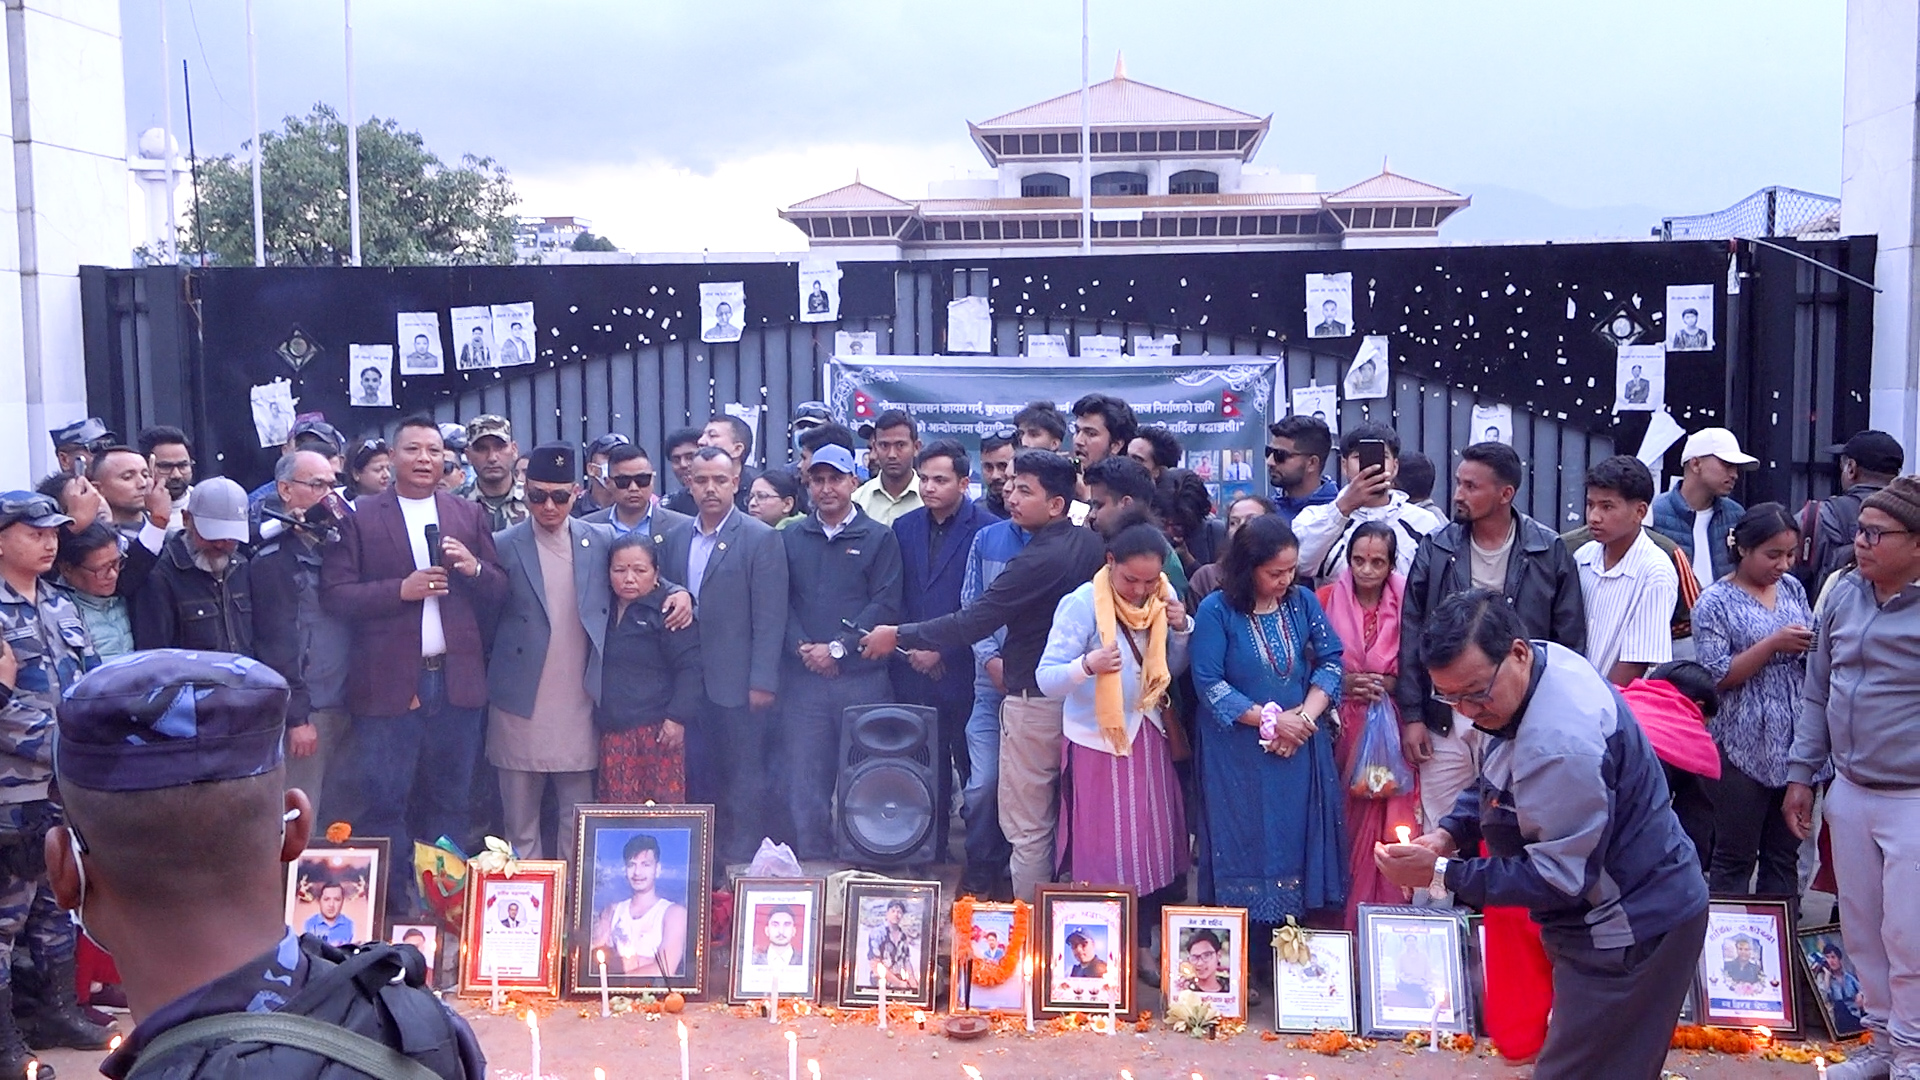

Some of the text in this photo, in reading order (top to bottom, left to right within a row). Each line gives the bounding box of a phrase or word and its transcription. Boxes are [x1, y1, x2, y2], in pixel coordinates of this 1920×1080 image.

[908, 402, 940, 415] सुशासन
[941, 403, 967, 413] कायम
[1153, 400, 1193, 414] निर्माणको
[1194, 399, 1215, 413] लागि
[928, 420, 974, 434] आन्दोलनमा
